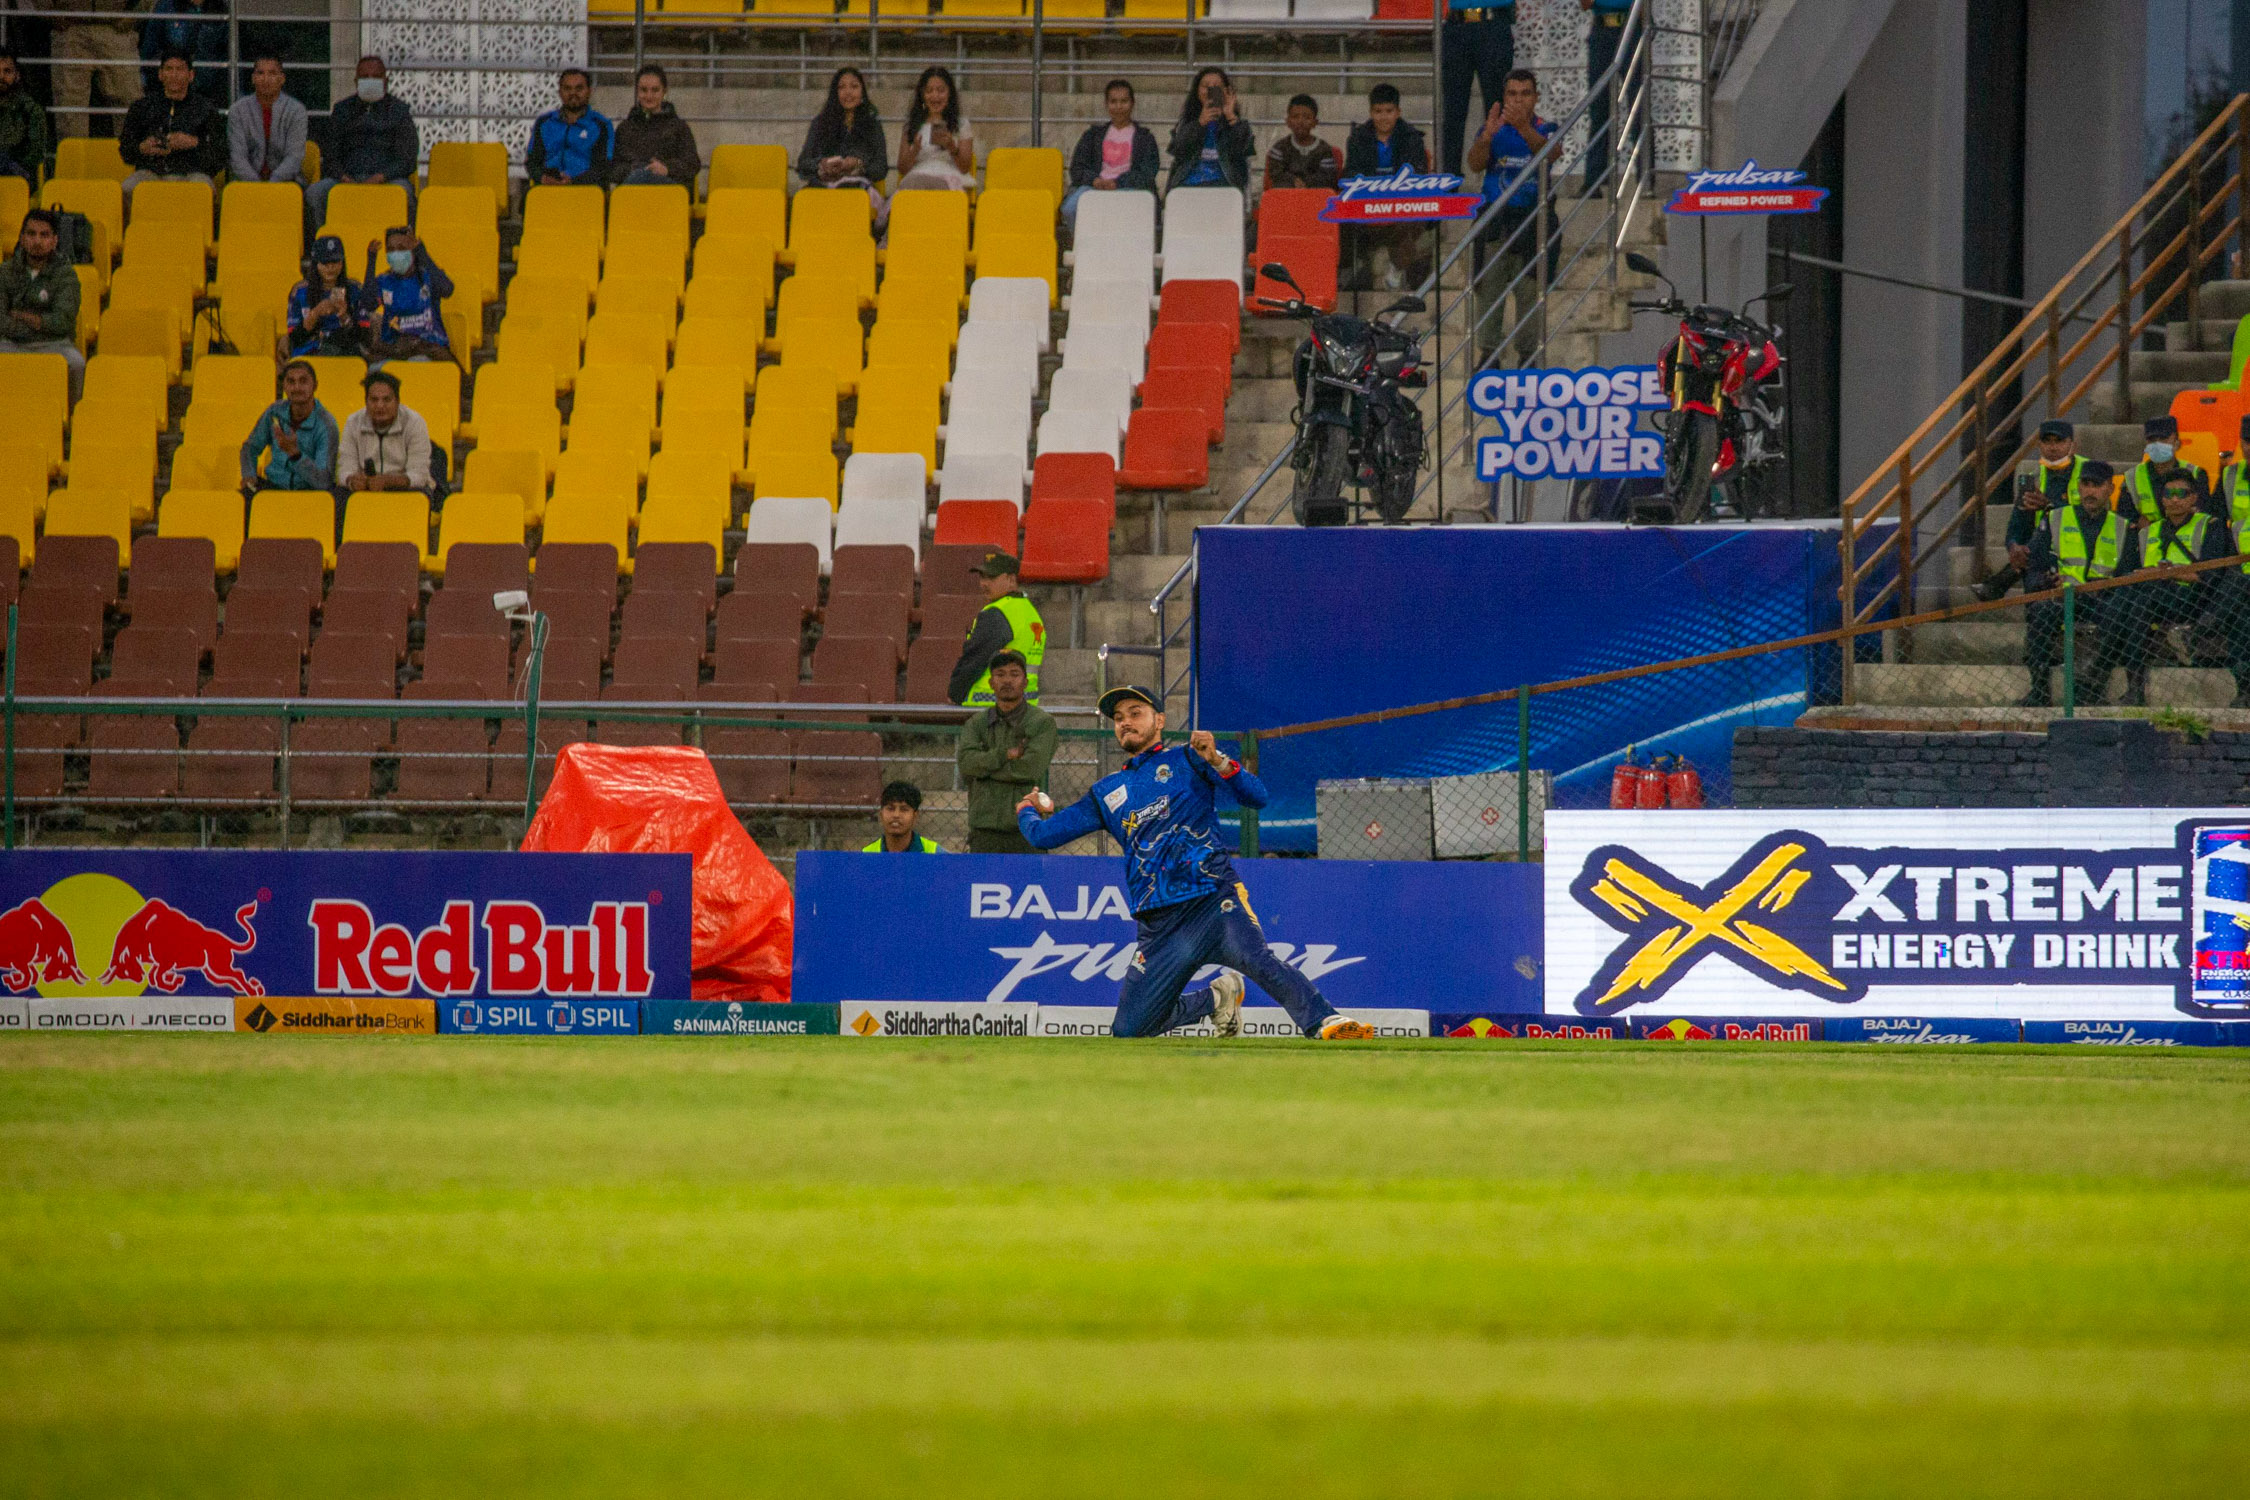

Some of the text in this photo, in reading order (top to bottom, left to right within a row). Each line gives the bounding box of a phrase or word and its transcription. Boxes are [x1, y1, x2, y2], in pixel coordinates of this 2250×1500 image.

[1342, 166, 1461, 202] pulsar
[1686, 161, 1803, 195] pulsar
[1364, 202, 1439, 213] RAW POWER
[1699, 195, 1793, 206] REFINED POWER
[1472, 371, 1668, 410] CHOOSE
[1501, 406, 1631, 442] YOUR
[1482, 438, 1661, 476] POWER
[970, 883, 1133, 921] BAJA
[1831, 864, 2183, 922] XTREME
[308, 898, 655, 997] Red Bull
[1832, 934, 2181, 968] ENERGY DRINK
[2196, 950, 2250, 969] XTR
[38, 1014, 125, 1026] OMODA
[488, 1007, 537, 1027] SPIL
[581, 1008, 631, 1027] SPIL
[673, 1019, 806, 1033] SANIMA RELIANCE
[1863, 1019, 1921, 1030] BAJAJ
[1045, 1023, 1113, 1036] OMOD
[2064, 1023, 2124, 1033] BAJAJ
